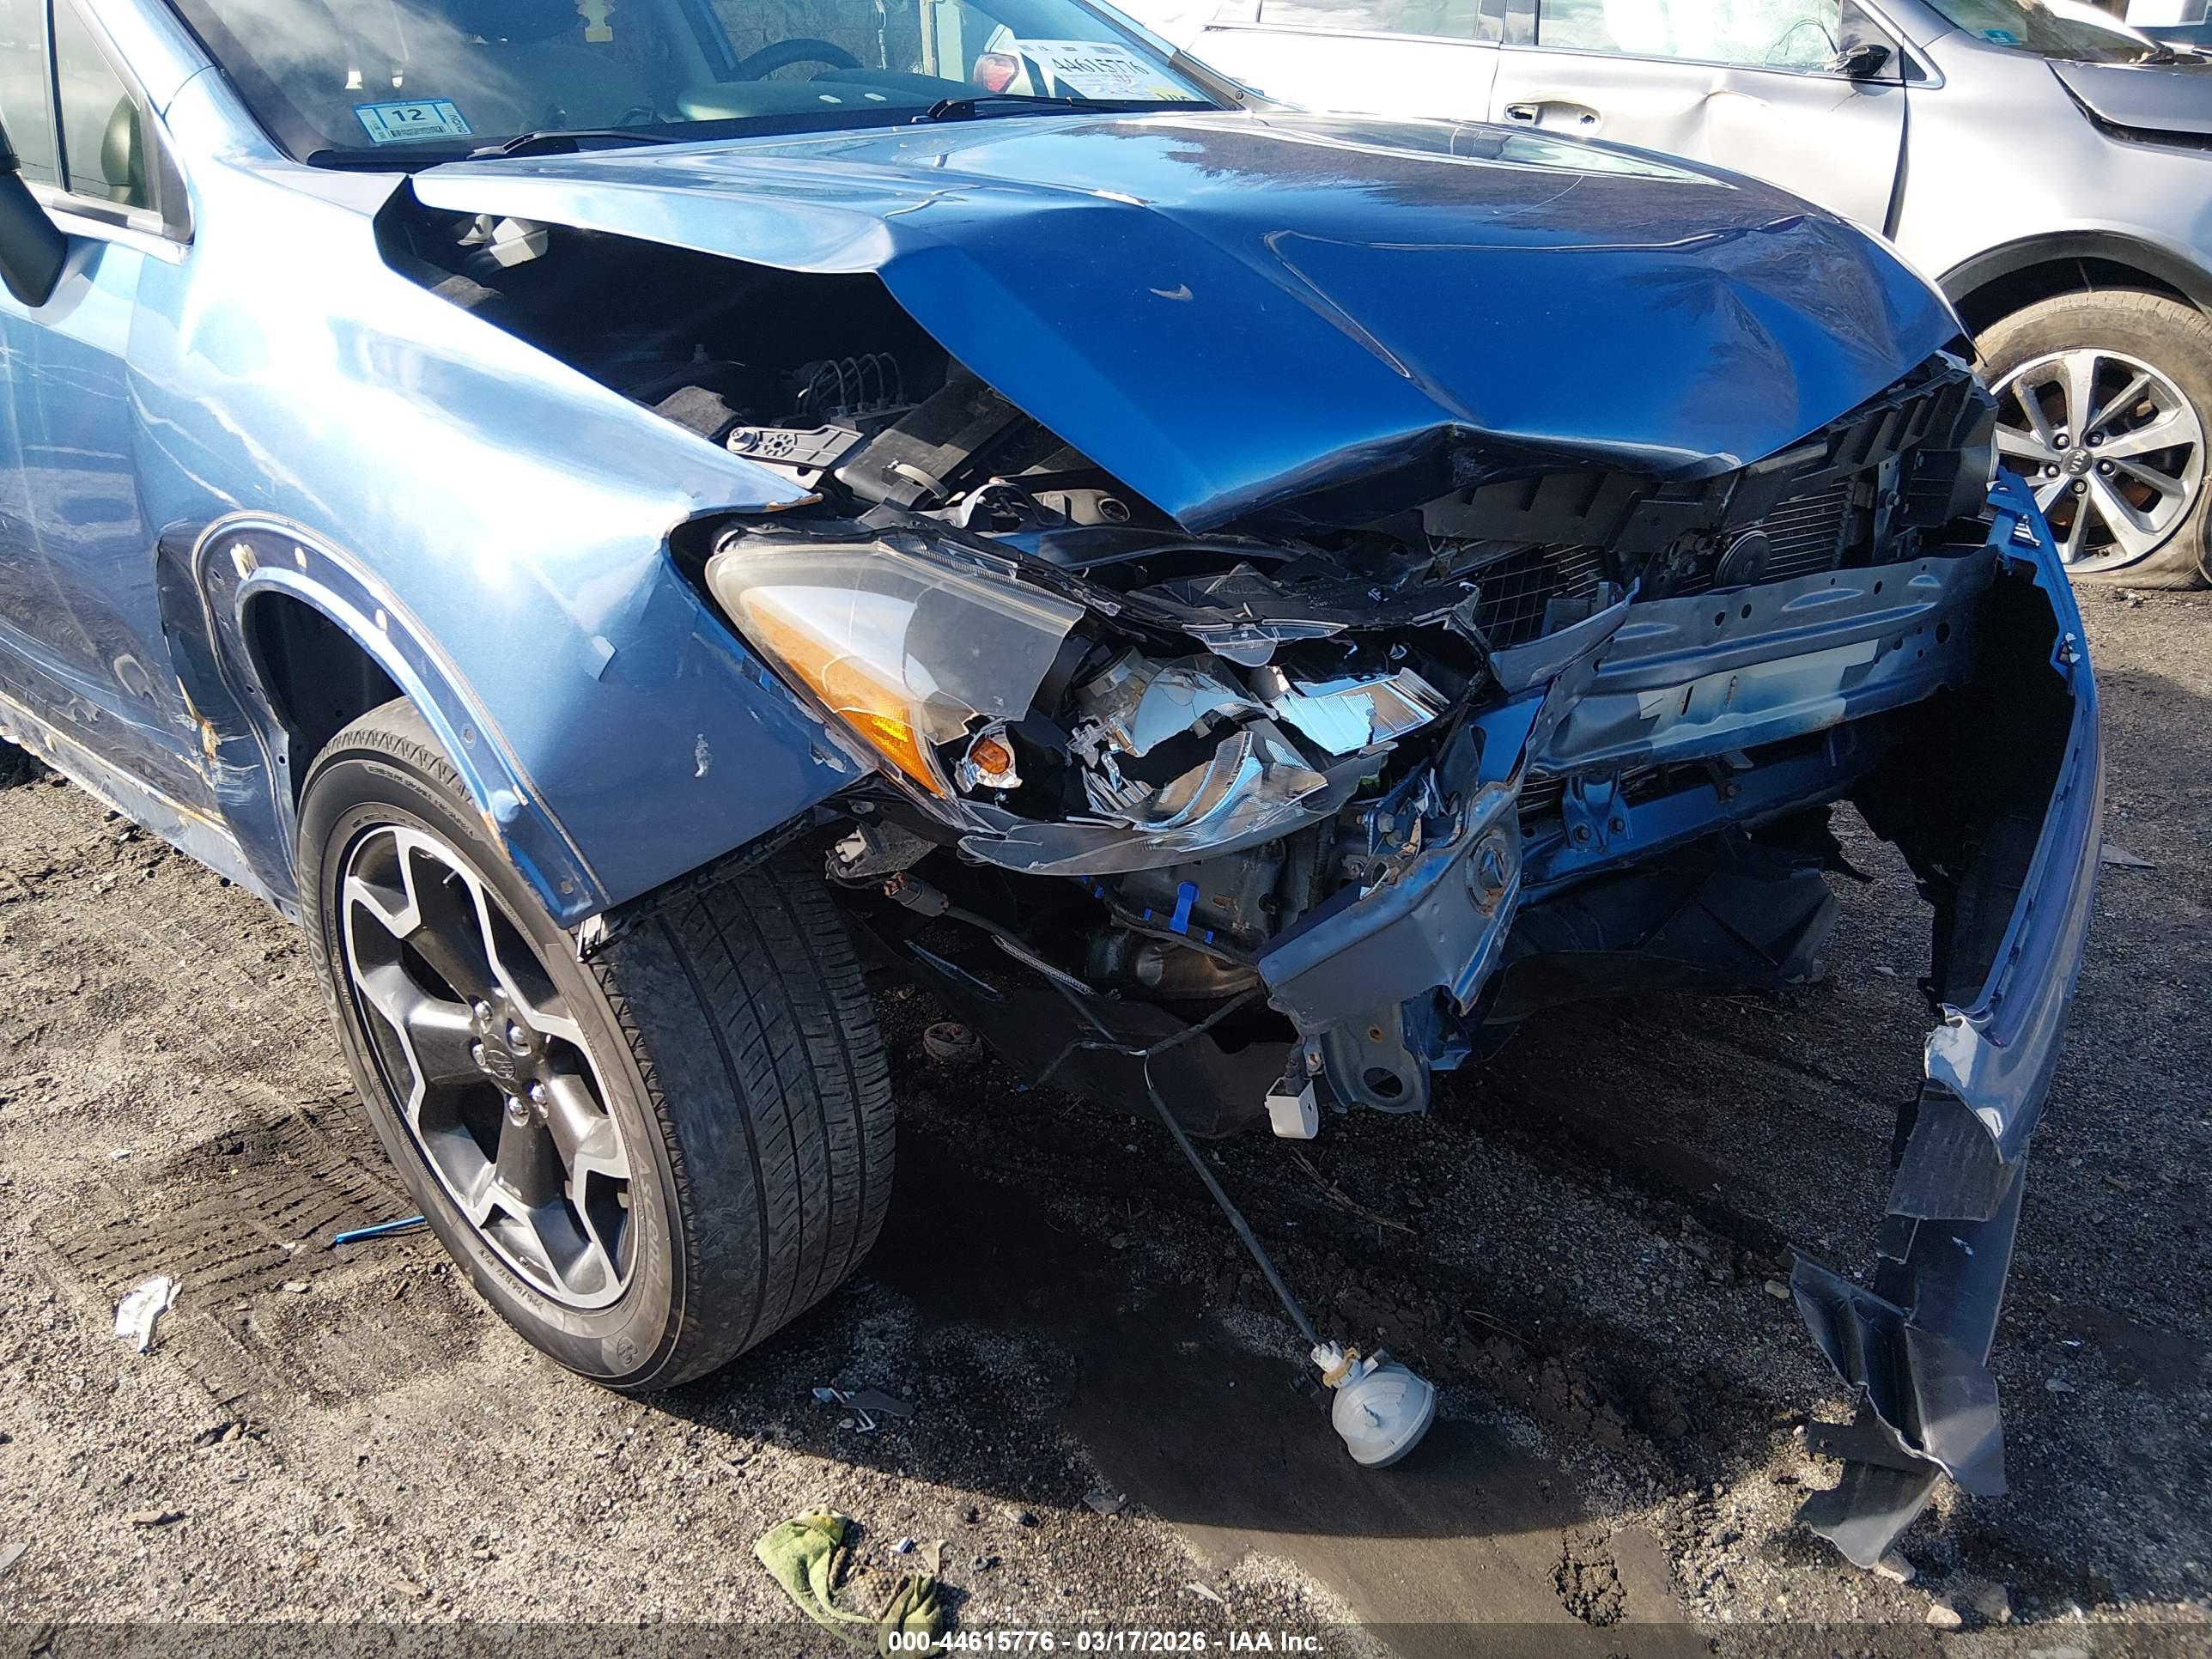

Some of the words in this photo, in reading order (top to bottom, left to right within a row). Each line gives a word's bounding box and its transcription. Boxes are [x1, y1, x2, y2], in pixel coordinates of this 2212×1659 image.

[1051, 57, 1150, 76] 44615776
[391, 108, 426, 122] 12
[2069, 450, 2087, 471] KIA
